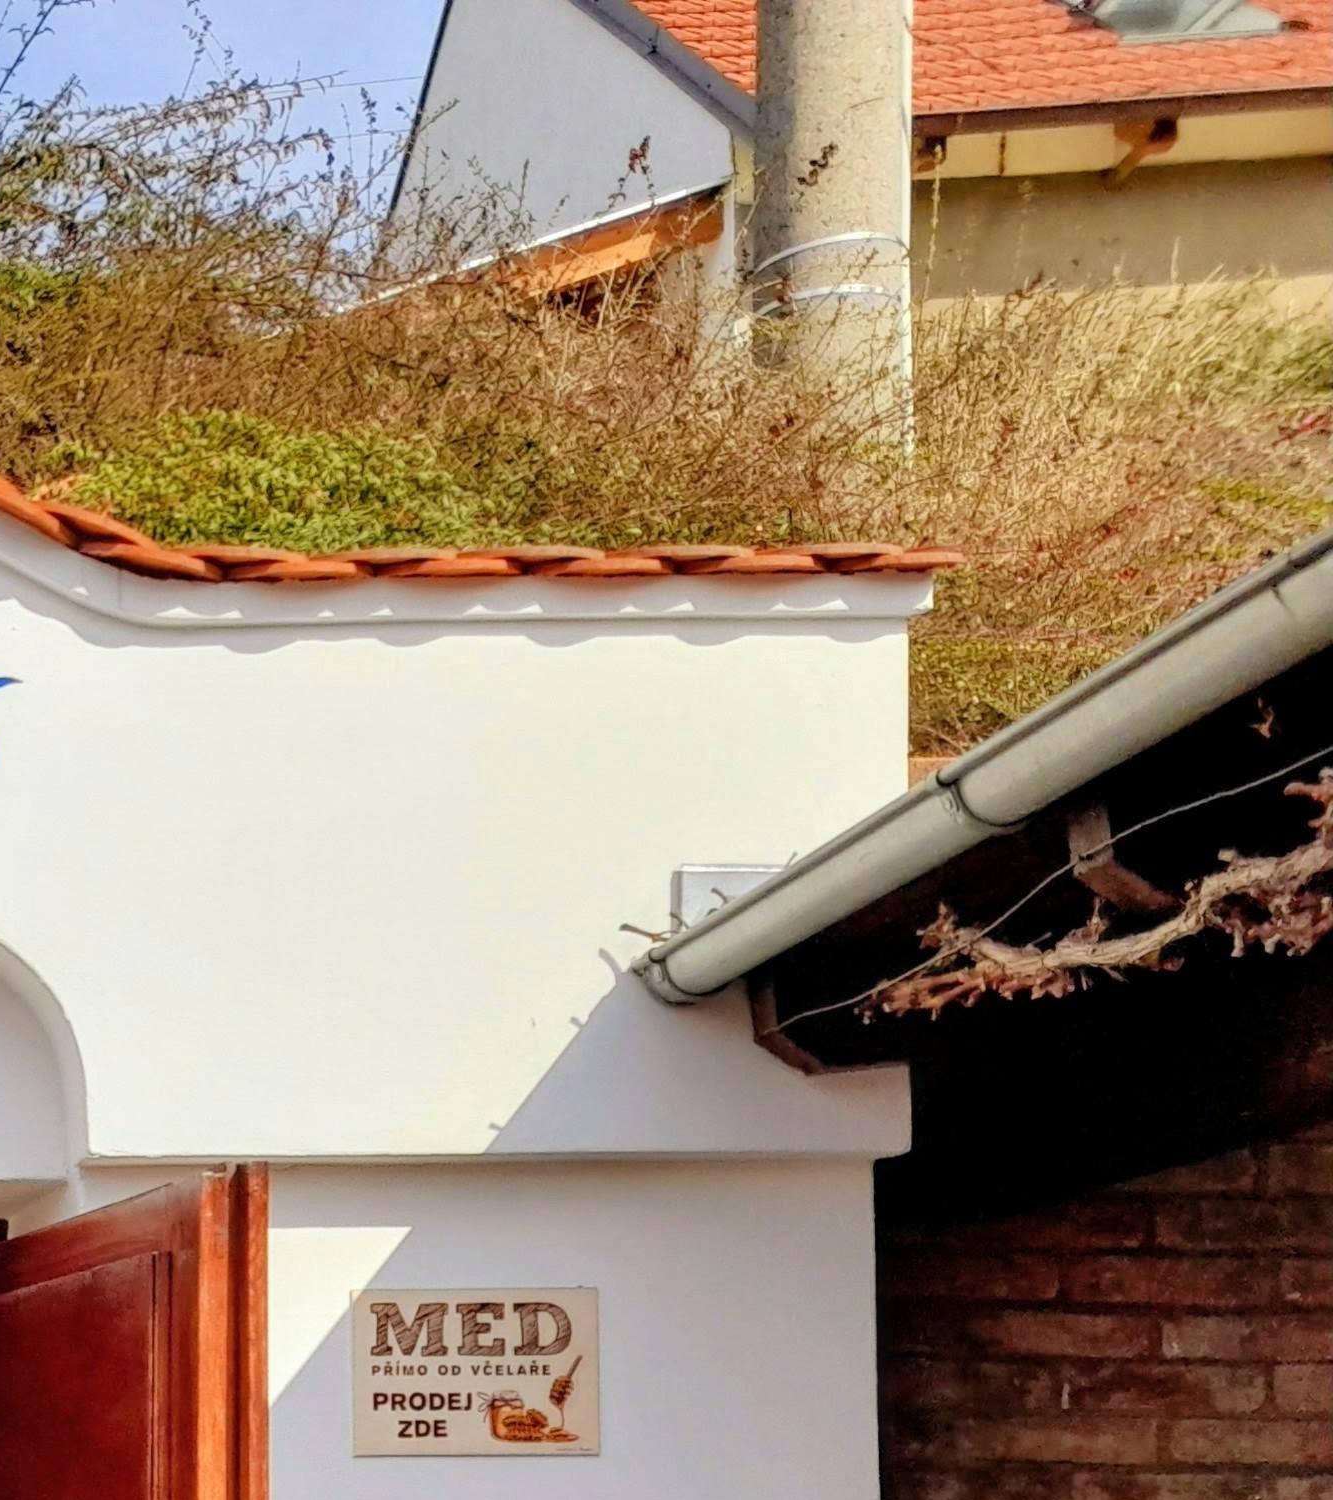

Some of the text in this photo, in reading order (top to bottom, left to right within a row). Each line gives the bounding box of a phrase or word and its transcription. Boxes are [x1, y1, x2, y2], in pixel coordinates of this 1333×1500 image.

[370, 1302, 573, 1357] MED
[371, 1360, 552, 1377] PŘÍMO OD VČELAŘE
[373, 1393, 473, 1412] PRODEJ
[398, 1420, 448, 1439] ZDE
